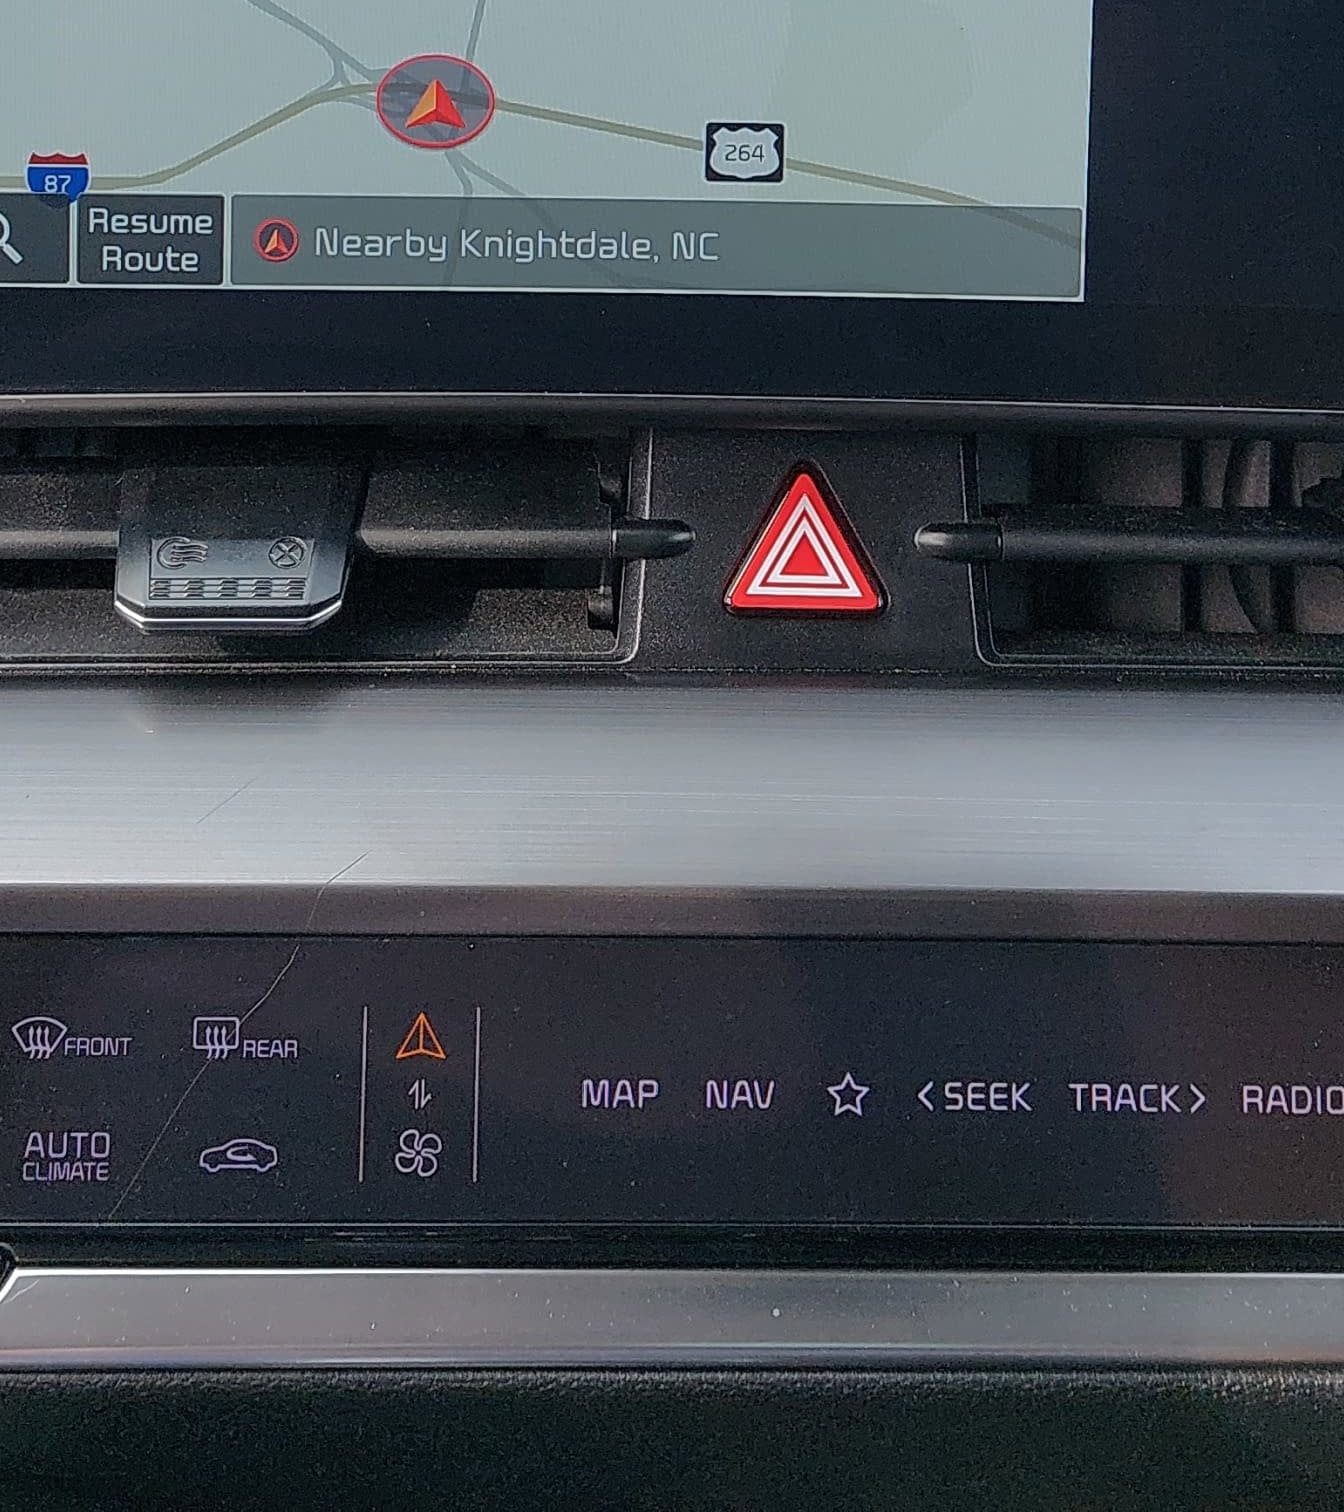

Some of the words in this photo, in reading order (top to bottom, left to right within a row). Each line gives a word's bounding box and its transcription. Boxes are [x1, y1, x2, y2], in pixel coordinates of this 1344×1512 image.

[724, 143, 765, 163] 264
[44, 174, 72, 193] 87
[87, 207, 214, 236] Resume
[101, 244, 200, 274] Route
[313, 226, 449, 264] Nearby
[460, 228, 661, 264] Knightdale,
[672, 231, 720, 262] NC
[63, 1036, 133, 1056] FRONT
[242, 1038, 299, 1059] REAR
[581, 1078, 659, 1109] MAP
[705, 1079, 775, 1110] NAV
[24, 1131, 111, 1159] AUTO
[22, 1161, 110, 1182] CLIMATE
